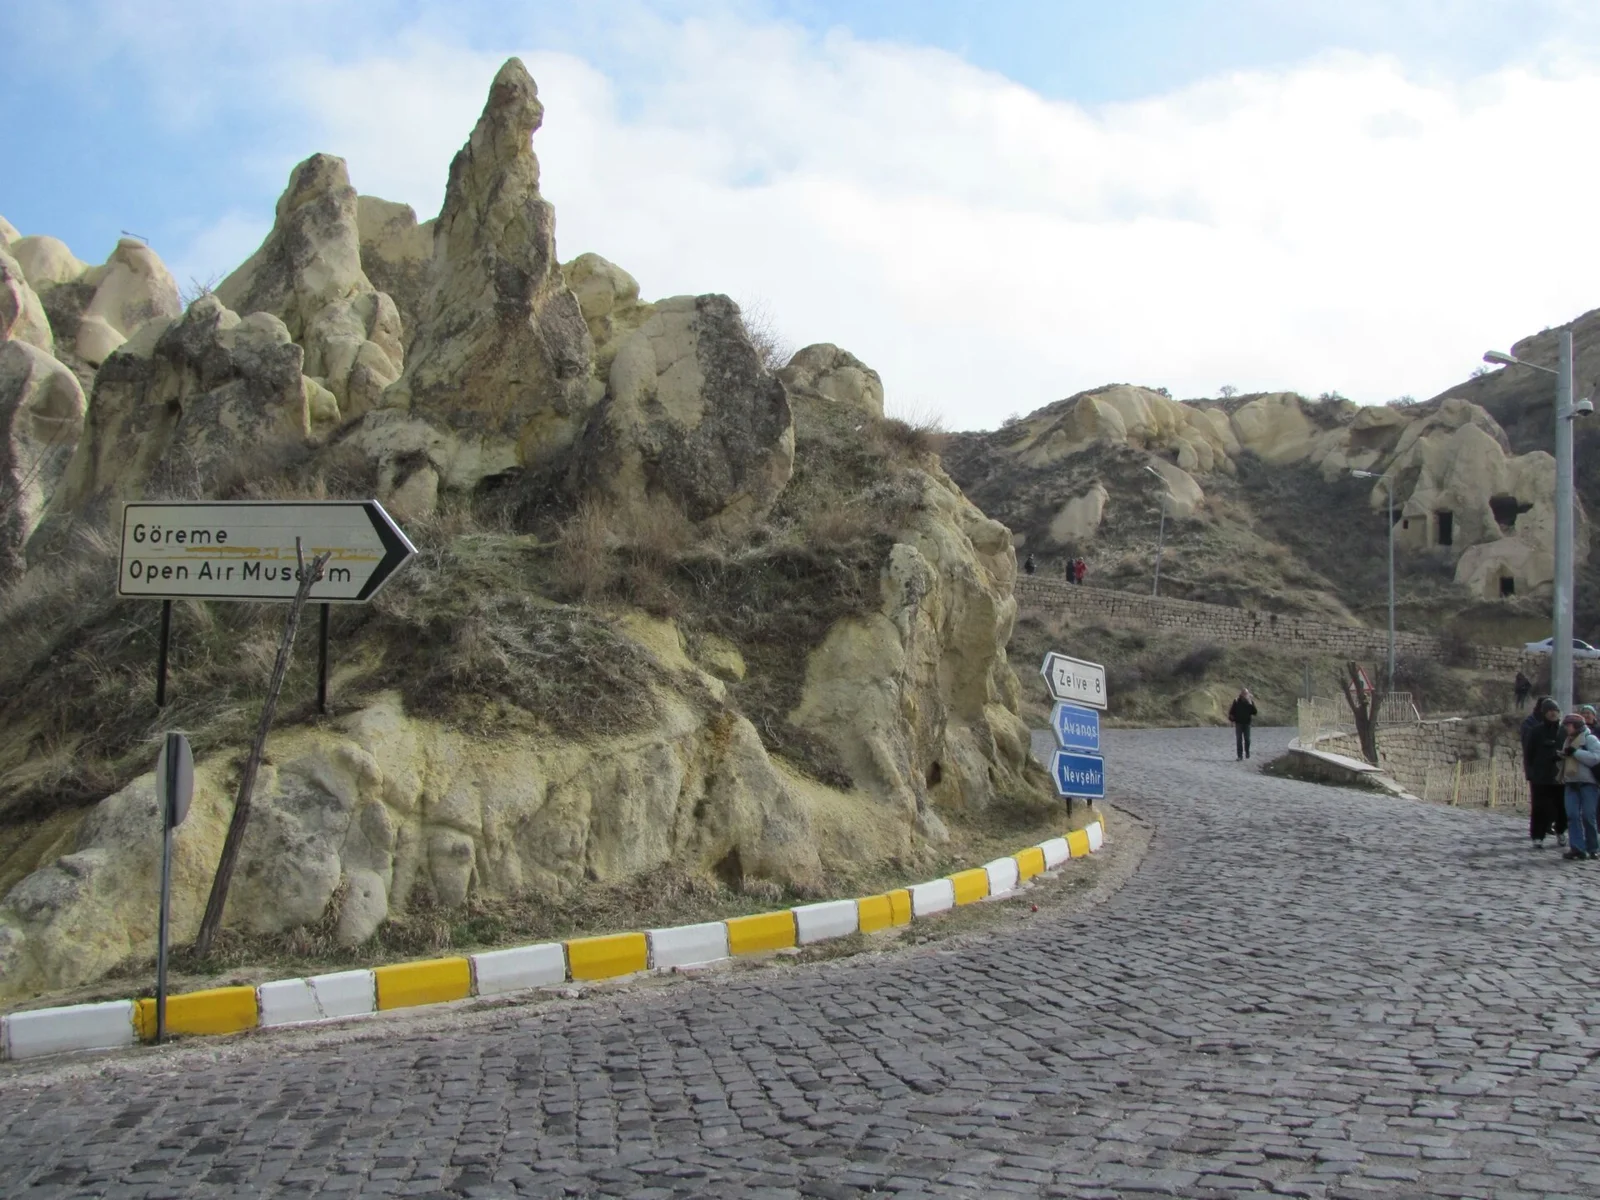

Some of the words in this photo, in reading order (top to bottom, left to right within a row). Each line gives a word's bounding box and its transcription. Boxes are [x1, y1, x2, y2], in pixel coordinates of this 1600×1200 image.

[133, 524, 228, 544] Göreme
[129, 560, 188, 583] Open
[243, 561, 351, 582] Musem
[1059, 669, 1088, 690] Zelve
[1095, 678, 1101, 694] 8
[1063, 765, 1101, 785] Nevşehir
